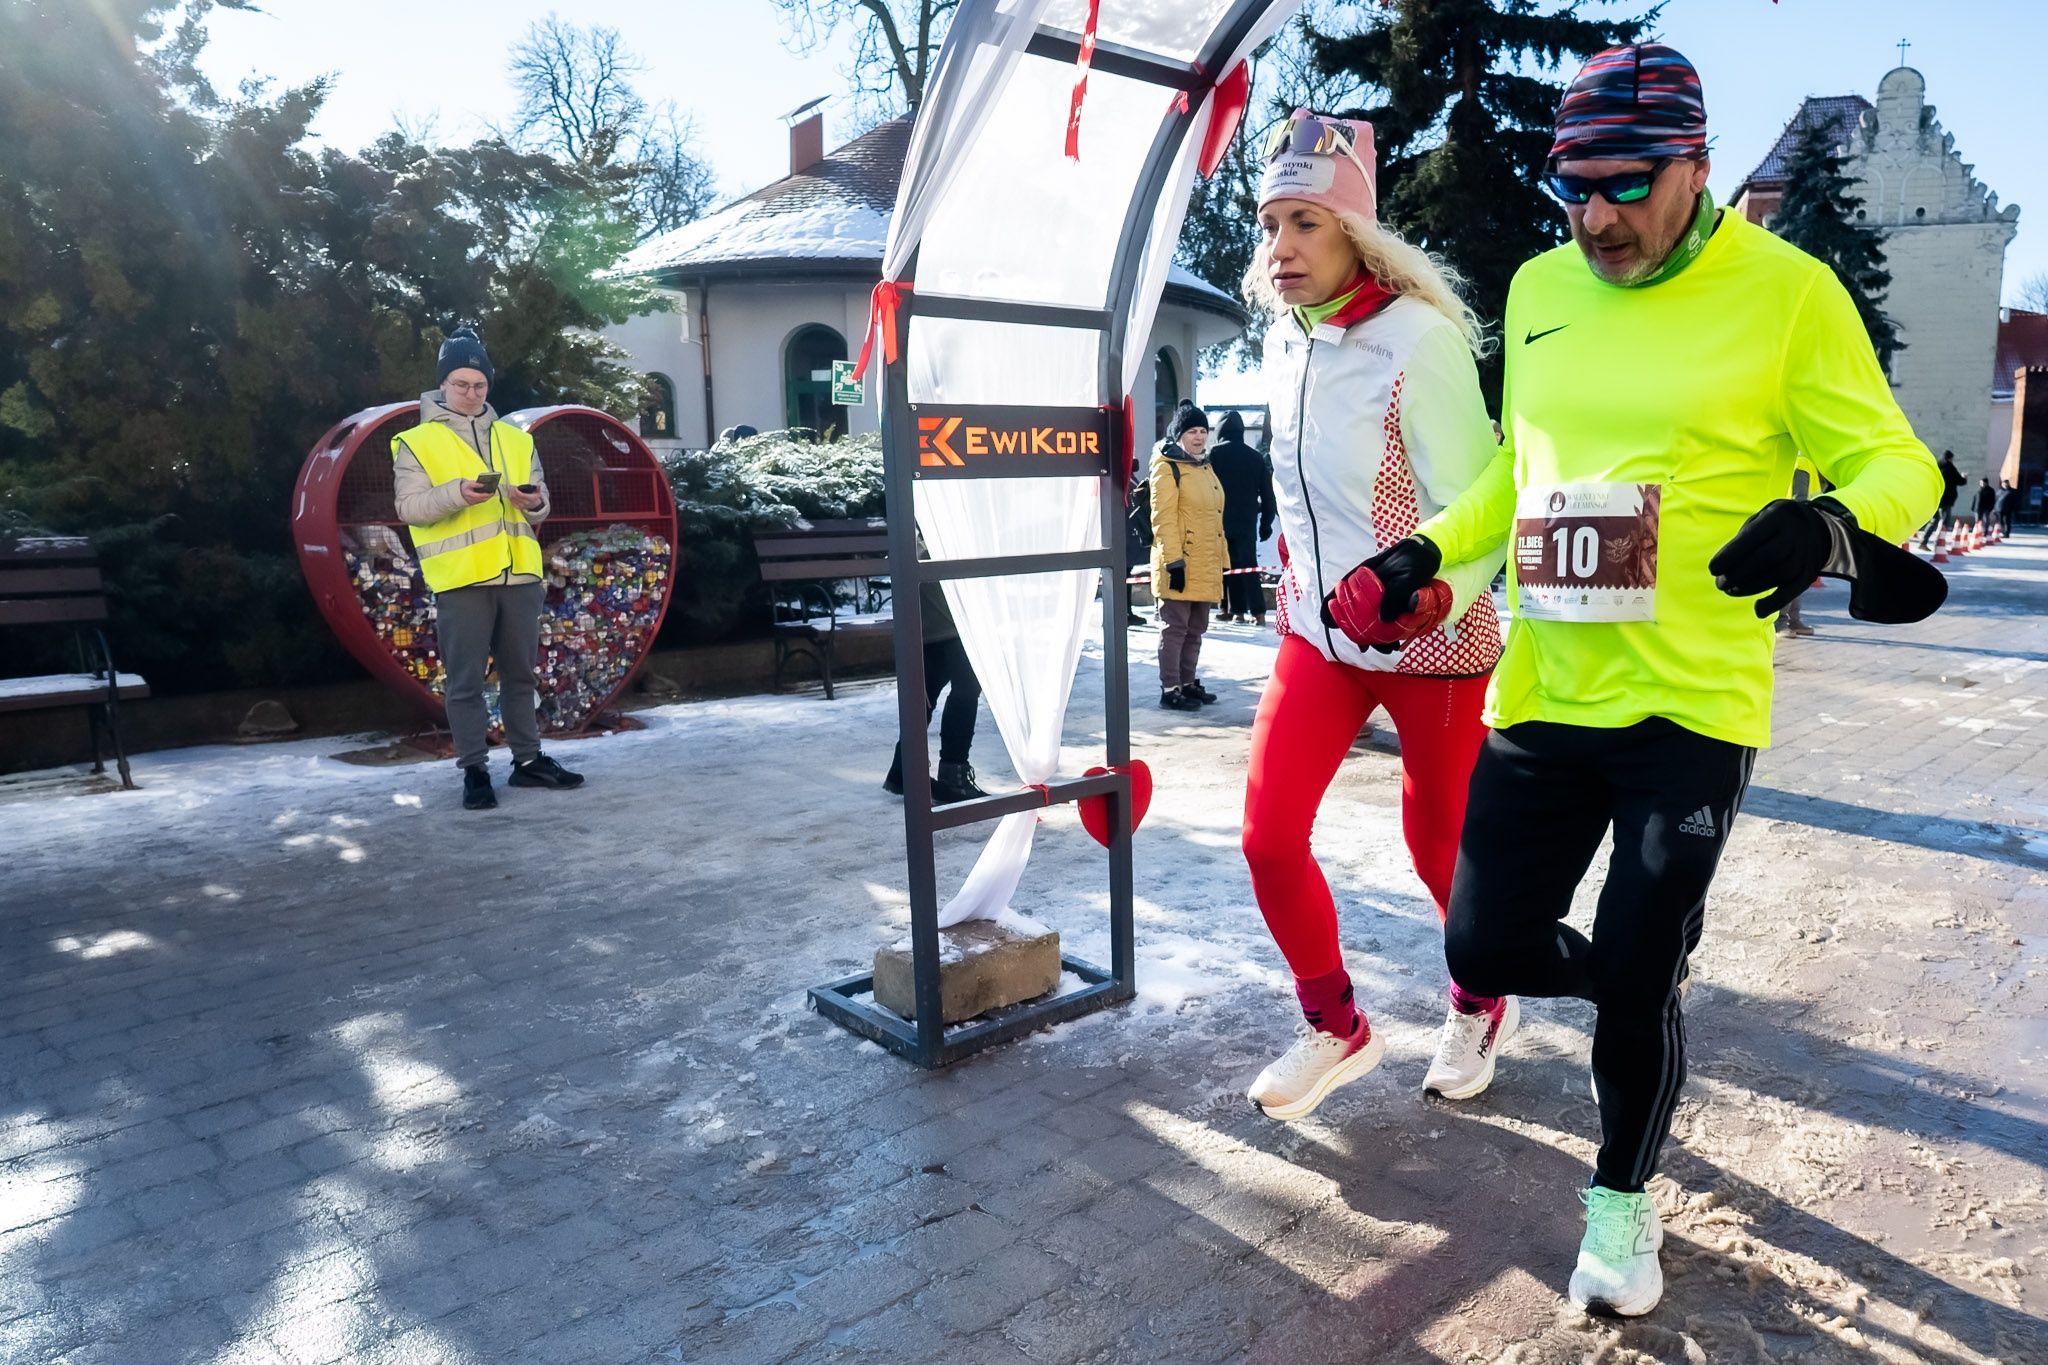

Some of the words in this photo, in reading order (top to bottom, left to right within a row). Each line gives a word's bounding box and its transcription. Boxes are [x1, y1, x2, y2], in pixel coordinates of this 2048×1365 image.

[1355, 340, 1394, 360] newline
[1552, 526, 1599, 578] 10
[1679, 822, 1716, 837] adidas
